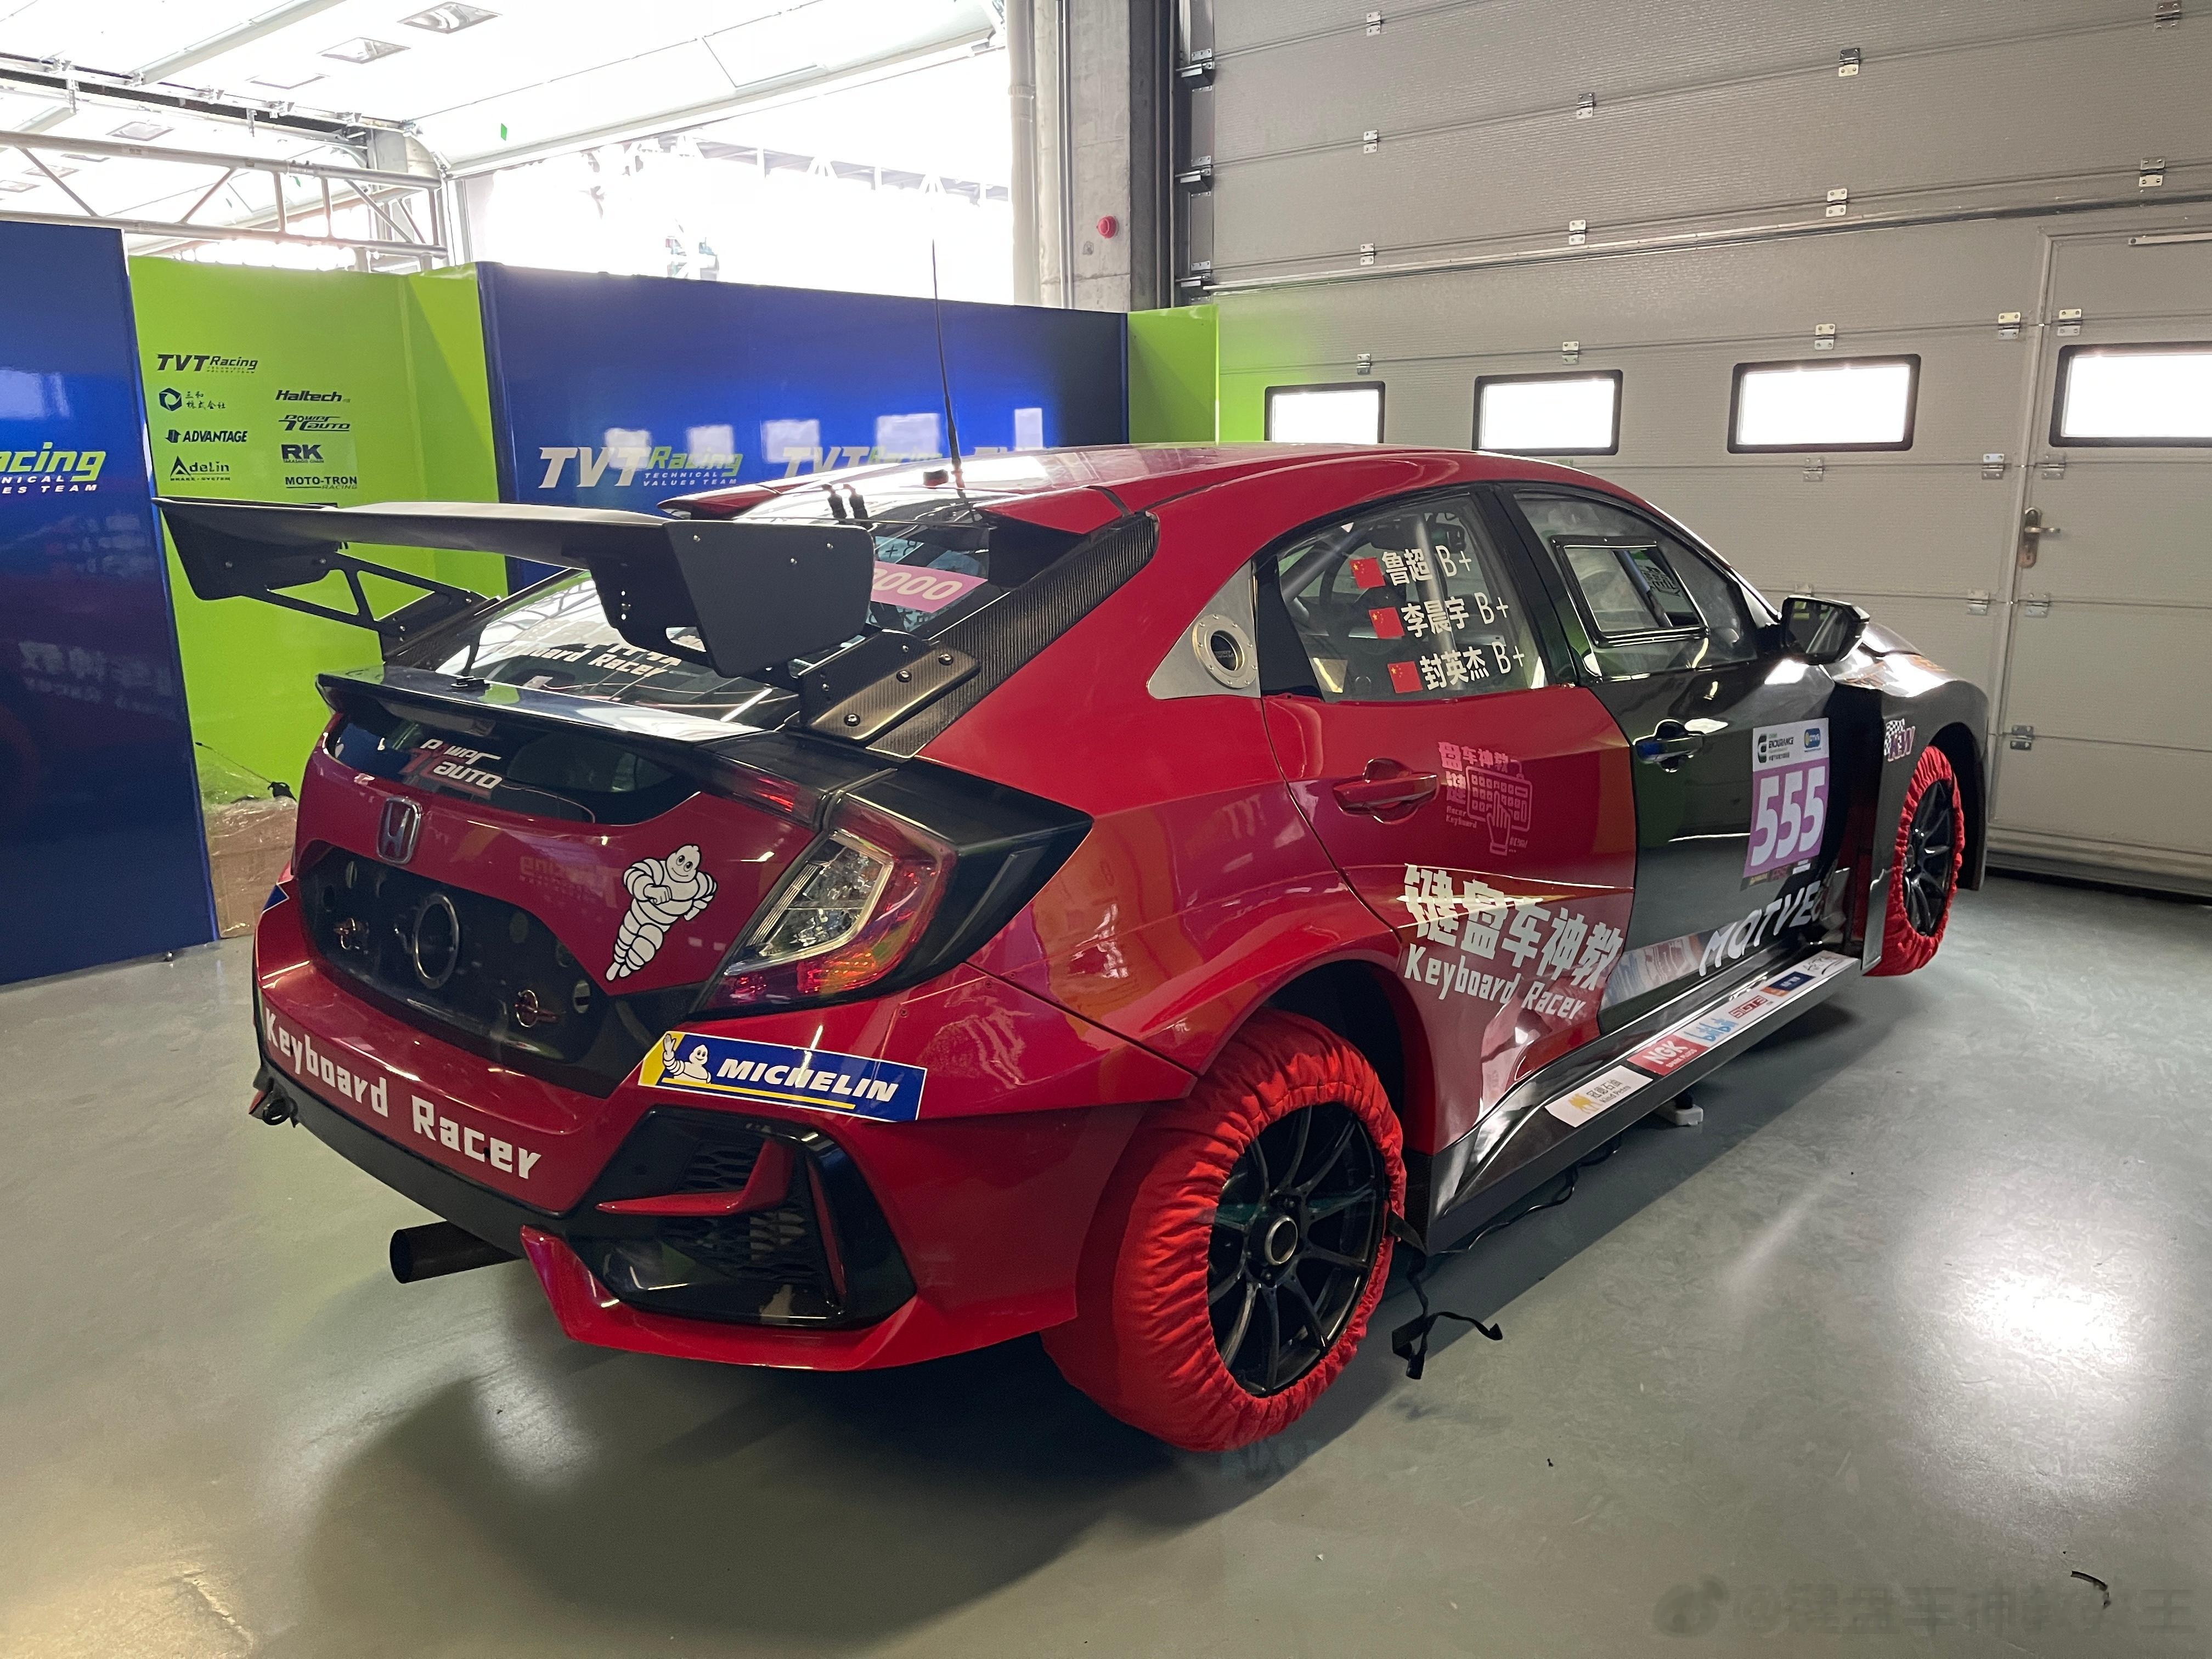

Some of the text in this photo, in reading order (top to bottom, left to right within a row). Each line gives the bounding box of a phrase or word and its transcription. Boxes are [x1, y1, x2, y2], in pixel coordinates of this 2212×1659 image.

[157, 354, 210, 372] TVT
[210, 356, 258, 370] Racing
[275, 390, 342, 402] Haltech
[183, 430, 247, 442] ADVANTAGE
[170, 455, 229, 477] Adelin
[281, 444, 323, 459] RK
[285, 476, 357, 485] MOTO-TRON
[538, 445, 743, 489] TVT Racing
[41, 484, 98, 493] TEAM
[1381, 549, 1433, 585] 鲁超
[1401, 596, 1469, 638] 李晨宇
[588, 653, 668, 678] Racer
[1419, 646, 1489, 690] 封英杰
[1751, 766, 1826, 867] 555
[1404, 863, 1624, 991] 键盘车神教
[1404, 943, 1587, 1019] Keyboard Racer
[1642, 1040, 1689, 1065] NGK
[265, 1008, 541, 1180] Keyboard Racer
[716, 1058, 898, 1102] MICHELIN
